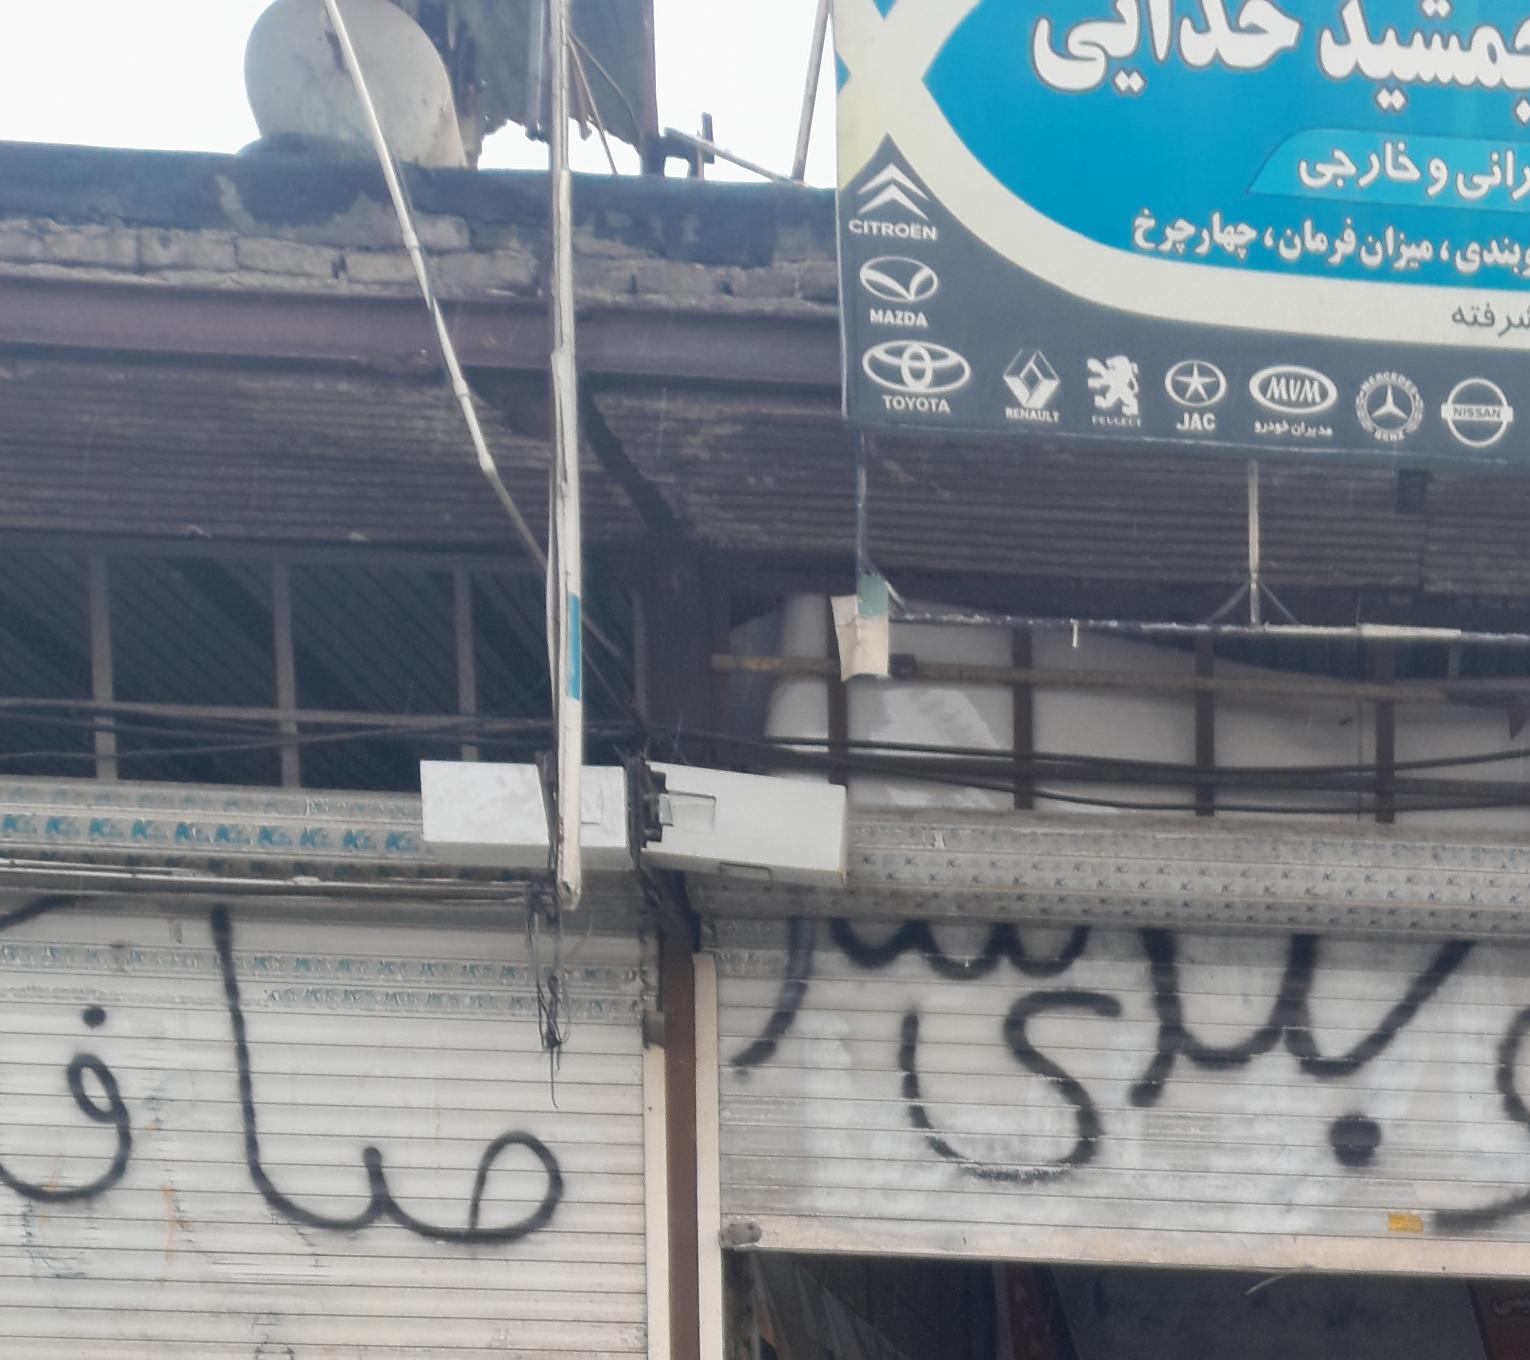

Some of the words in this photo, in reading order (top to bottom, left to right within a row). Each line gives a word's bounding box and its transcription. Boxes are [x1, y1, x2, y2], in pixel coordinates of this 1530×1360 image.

[1299, 140, 1422, 189] خارجی
[1426, 154, 1449, 197] و
[849, 219, 938, 241] CITROËN
[1359, 225, 1433, 271] میزان
[870, 308, 928, 327] MAZDA
[1266, 376, 1322, 402] MVM
[882, 395, 950, 413] TOYOTA
[1453, 406, 1501, 420] NISSAN
[1005, 407, 1060, 423] RENAULT
[1176, 412, 1216, 432] JAC
